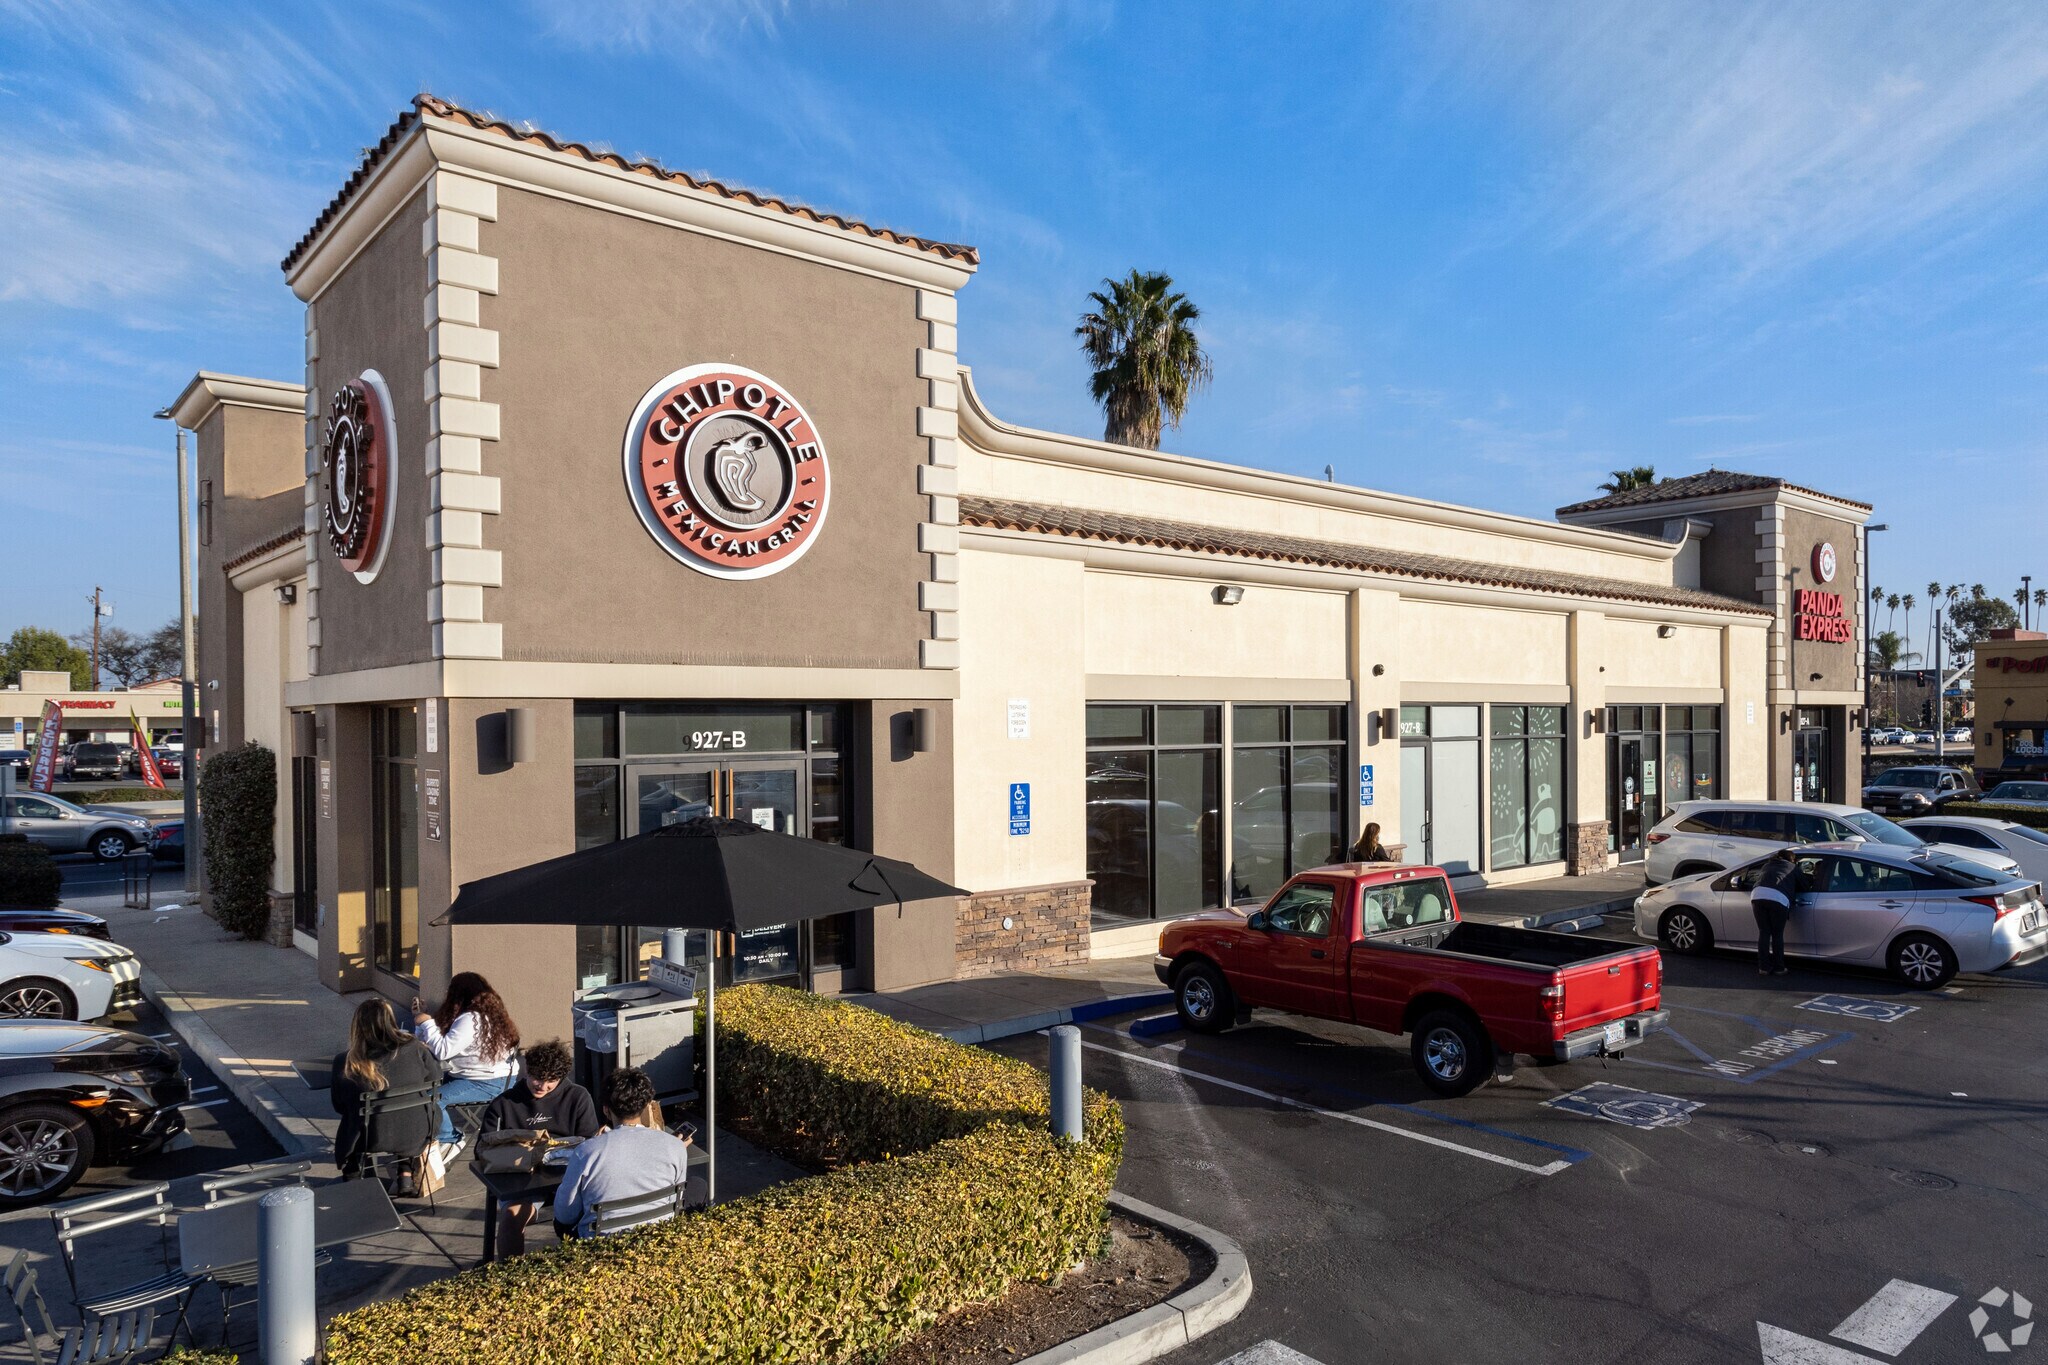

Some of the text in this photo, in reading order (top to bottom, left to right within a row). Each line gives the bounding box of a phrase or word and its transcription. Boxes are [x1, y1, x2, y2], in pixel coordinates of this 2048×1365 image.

[660, 379, 820, 463] CHIPOTLE
[664, 480, 817, 554] MEXICAN GRILL
[1798, 589, 1844, 617] PANDA
[1799, 614, 1852, 642] EXPRESS
[60, 701, 116, 709] PHARMACY
[692, 730, 746, 749] 927-B
[2015, 746, 2043, 754] LOCOS
[1701, 1028, 1829, 1075] NO PARKING
